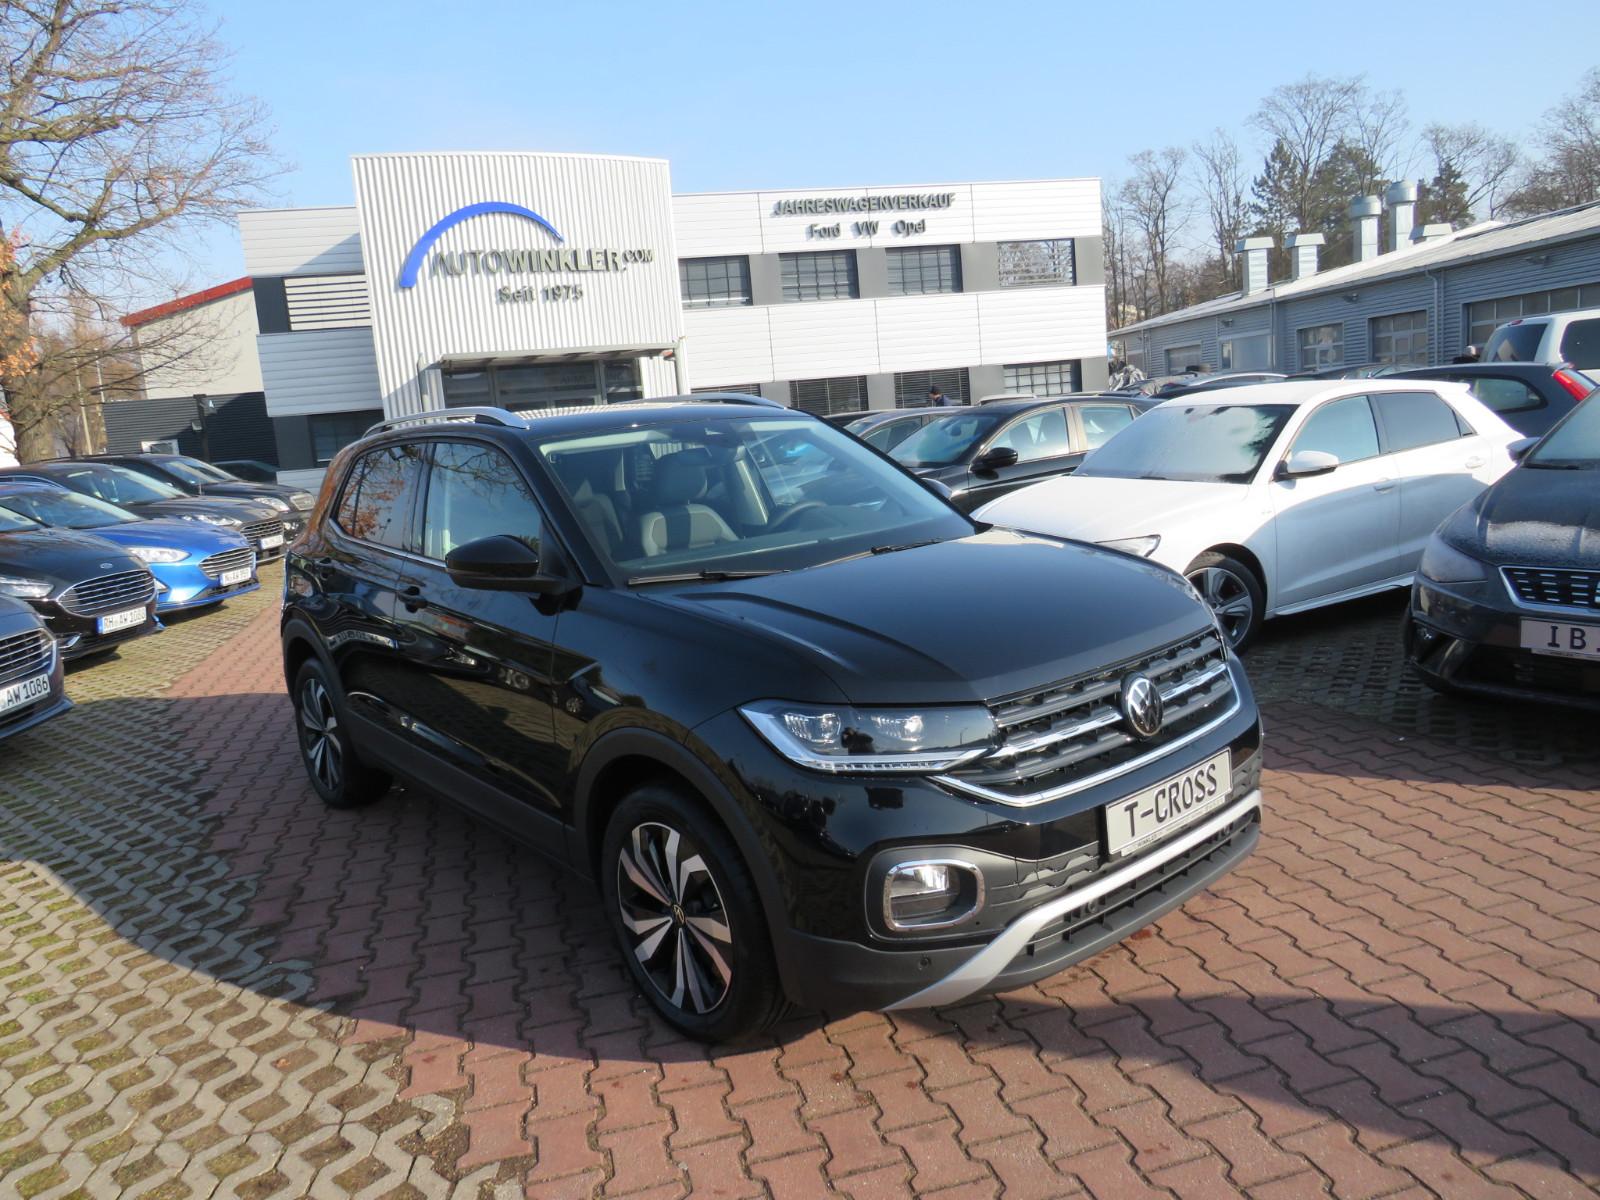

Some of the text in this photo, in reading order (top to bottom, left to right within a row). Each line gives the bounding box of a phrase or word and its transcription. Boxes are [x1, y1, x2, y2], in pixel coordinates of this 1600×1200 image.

[773, 192, 955, 216] JAHRESWAGENVERKAUF
[809, 218, 926, 239] Ford VW Opel
[498, 283, 583, 303] Seit 1975
[6, 675, 49, 707] AW 1086
[1124, 763, 1217, 838] T-CROSS
